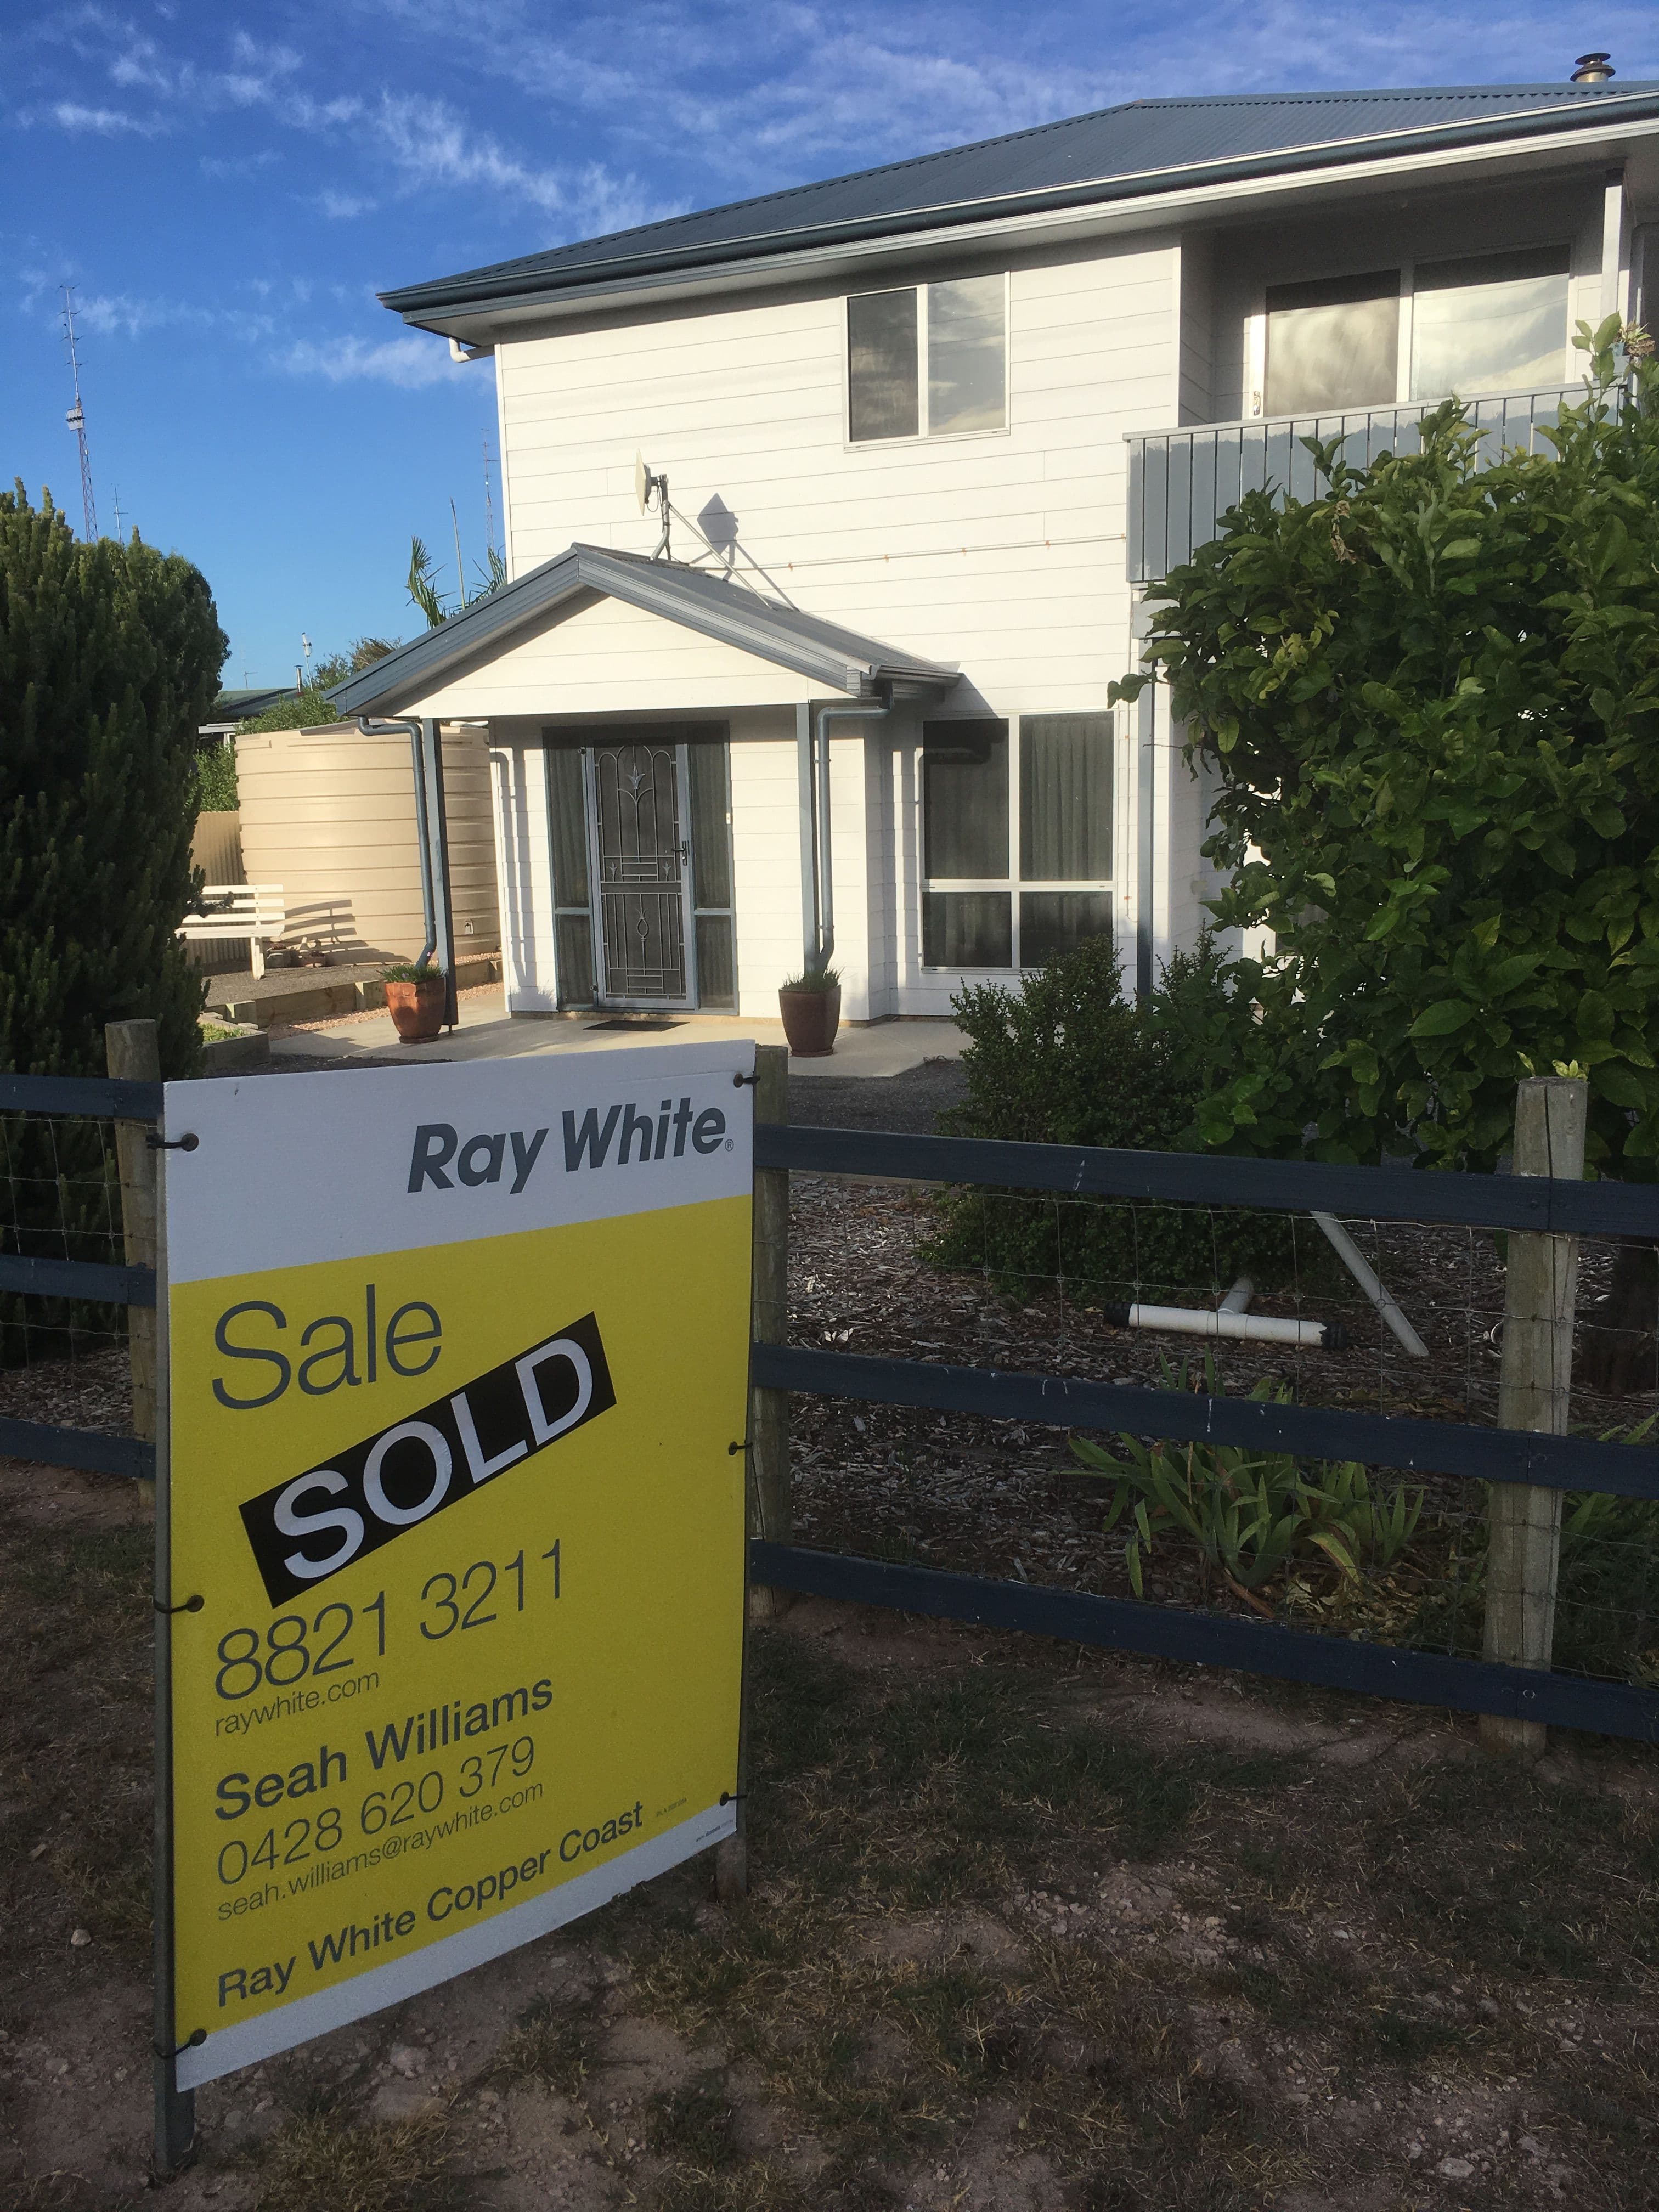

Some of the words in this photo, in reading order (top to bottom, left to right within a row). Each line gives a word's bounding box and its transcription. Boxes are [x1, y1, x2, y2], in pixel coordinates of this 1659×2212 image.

[408, 1122, 549, 1194] Ray
[212, 1284, 442, 1409] Sale
[273, 1338, 594, 1579] SOLD
[215, 1591, 387, 1700] 8821
[419, 1538, 562, 1640] 3211
[215, 1669, 379, 1737] raywhite.com
[215, 1746, 347, 1821] Seah
[365, 1678, 554, 1771] Williams
[218, 1808, 343, 1886] 0428
[360, 1770, 443, 1836] 620
[458, 1735, 535, 1797] 379
[218, 1780, 544, 1921] seah.williams@raywhite.com
[219, 1956, 296, 2008] Ray
[308, 1910, 416, 1971] White
[426, 1849, 551, 1922] Copper
[558, 1801, 643, 1863] Coast
